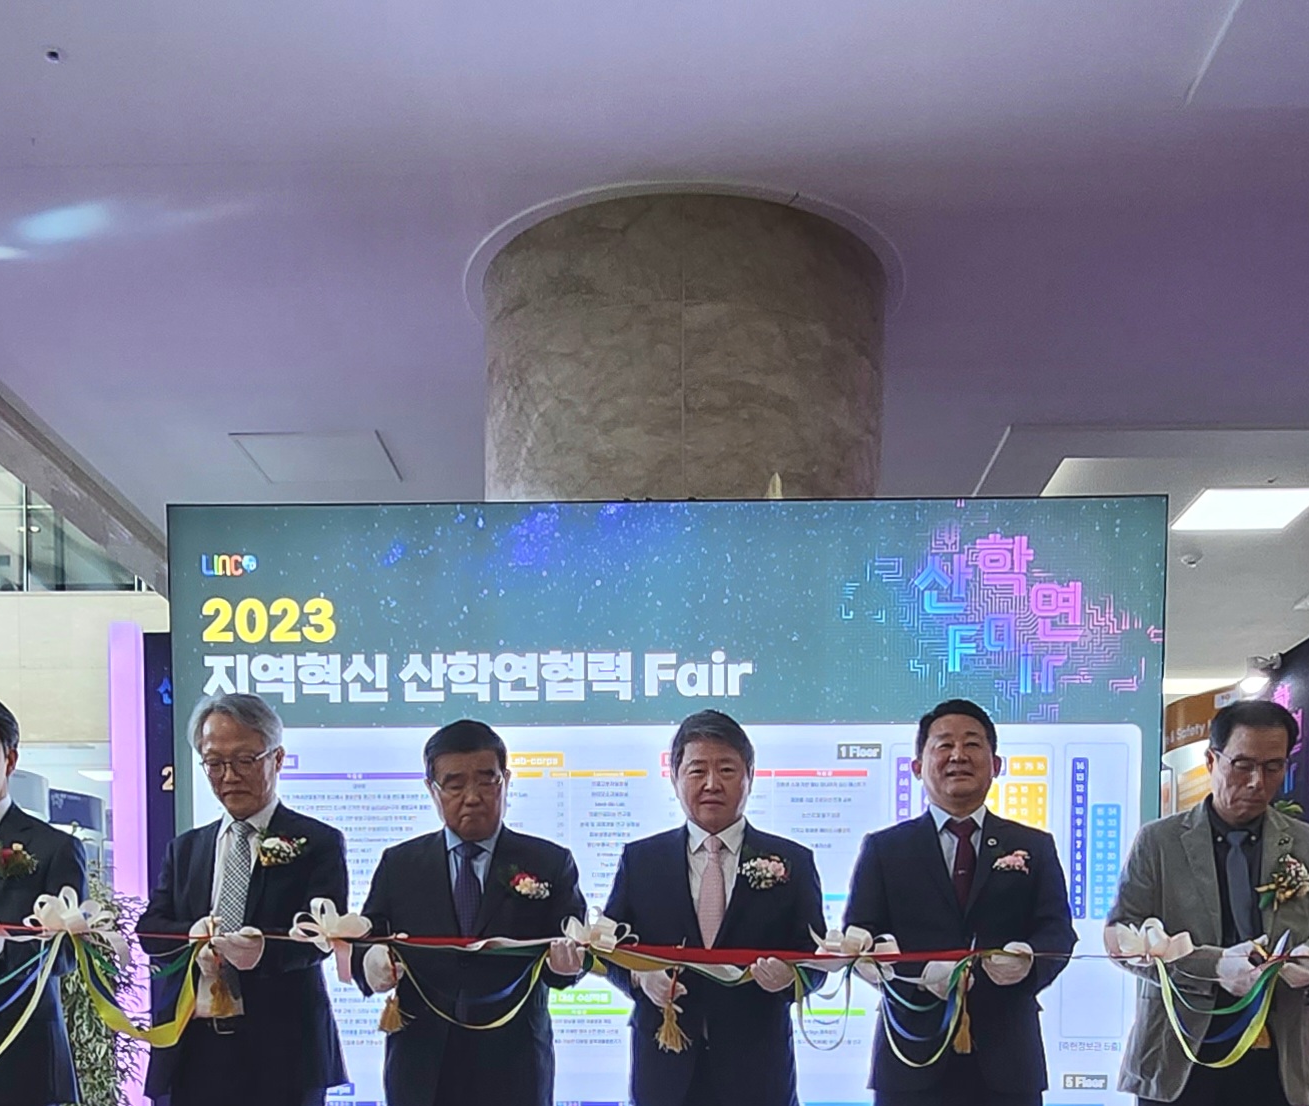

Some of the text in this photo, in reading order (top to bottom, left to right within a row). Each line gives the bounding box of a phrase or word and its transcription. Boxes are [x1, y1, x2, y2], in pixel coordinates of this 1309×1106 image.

[201, 597, 336, 643] 2023
[201, 651, 753, 703] 지역혁신 산학연협력 Fair
[849, 746, 880, 757] Floor
[1075, 1076, 1105, 1088] Floor
